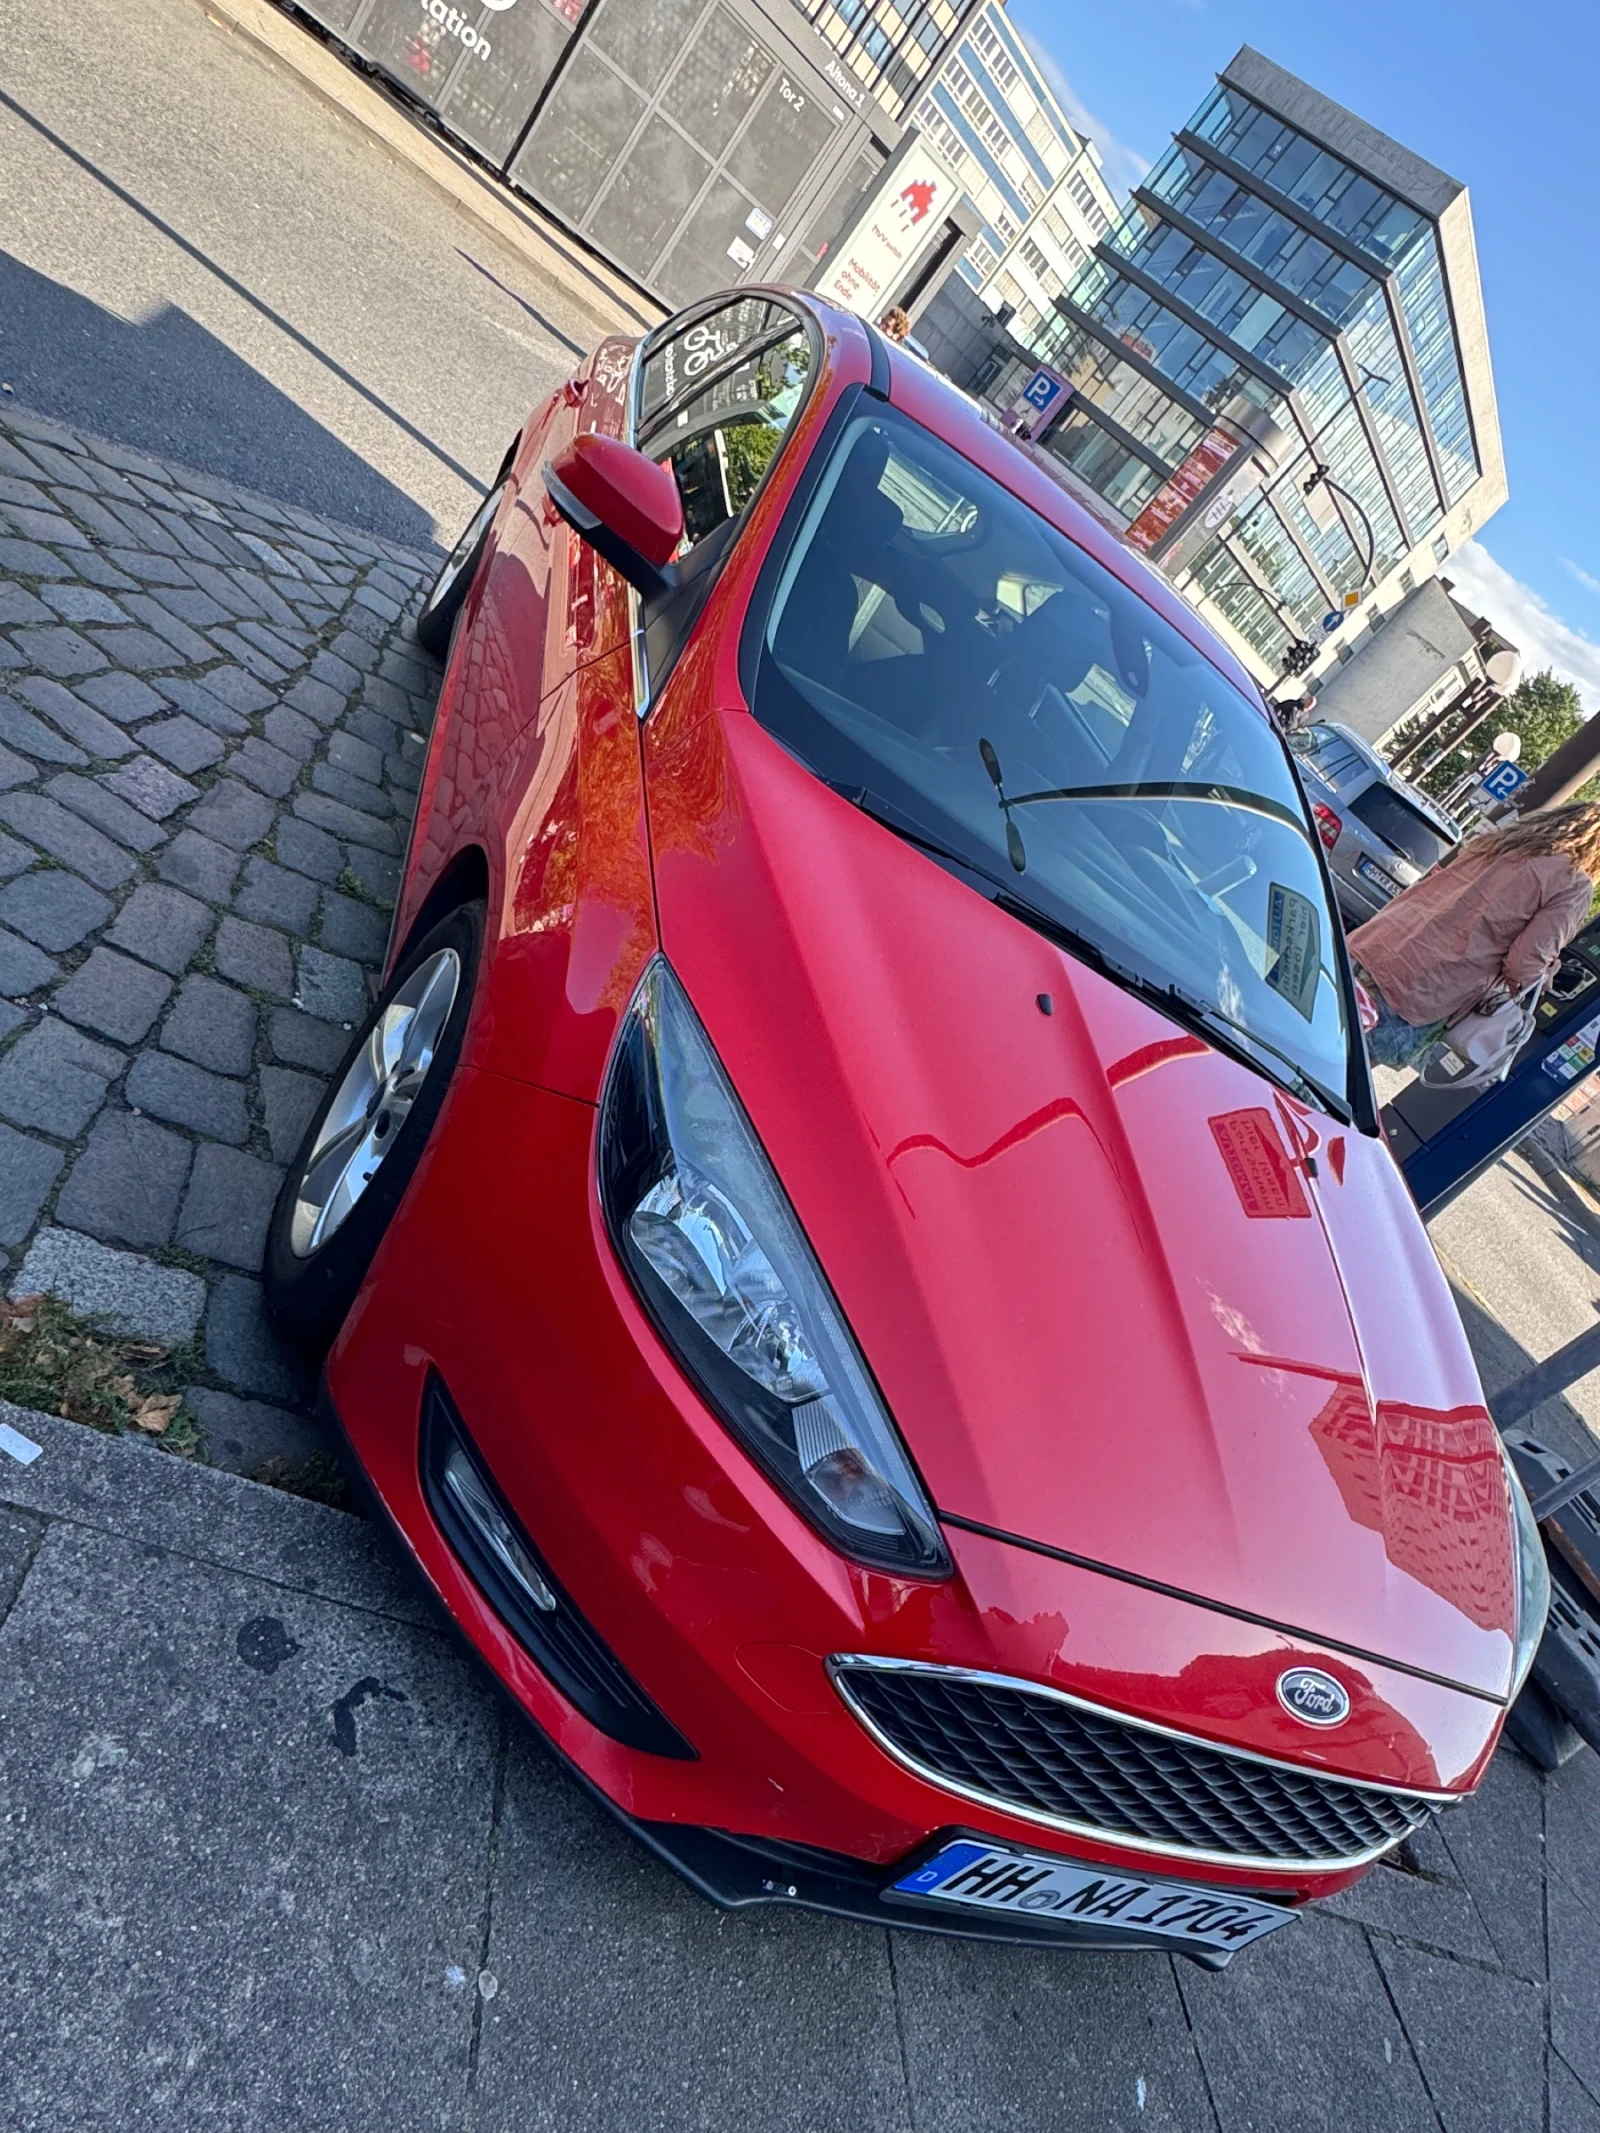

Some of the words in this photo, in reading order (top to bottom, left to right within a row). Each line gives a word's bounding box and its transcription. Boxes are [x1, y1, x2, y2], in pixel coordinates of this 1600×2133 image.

[779, 77, 797, 103] Tor
[793, 95, 805, 112] 2
[824, 60, 858, 101] Altona
[855, 93, 866, 109] 1
[833, 279, 853, 301] Ende
[841, 270, 860, 290] ohne
[848, 257, 881, 293] Mobilität
[1027, 376, 1051, 397] P
[1489, 766, 1518, 789] P
[1294, 1677, 1336, 1713] Ford
[916, 1870, 938, 1883] D
[941, 1858, 1055, 1903] HH
[1051, 1878, 1151, 1919] NA
[1123, 1891, 1276, 1942] 1704
